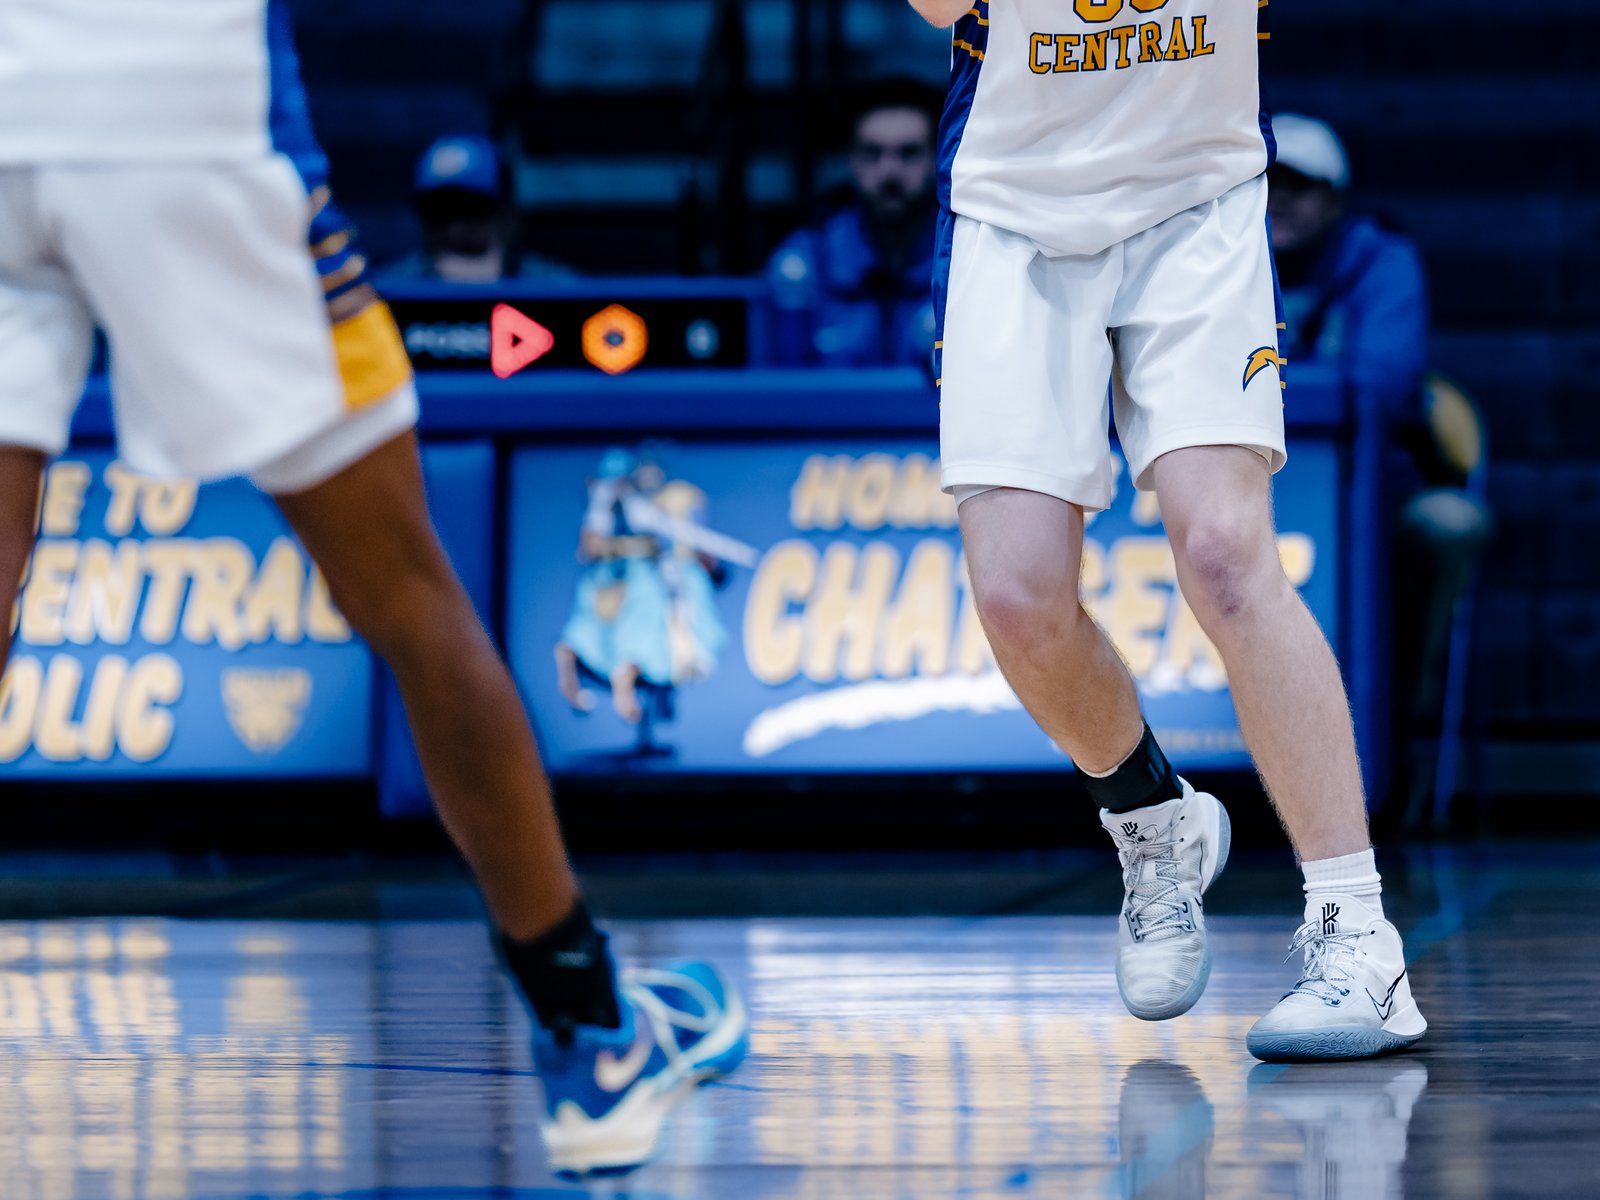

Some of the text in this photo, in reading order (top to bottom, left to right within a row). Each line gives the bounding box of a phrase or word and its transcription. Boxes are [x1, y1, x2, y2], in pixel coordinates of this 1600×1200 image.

[1029, 15, 1216, 75] CENTRAL
[790, 452, 960, 531] HOM
[10, 535, 353, 651] ENTRAL
